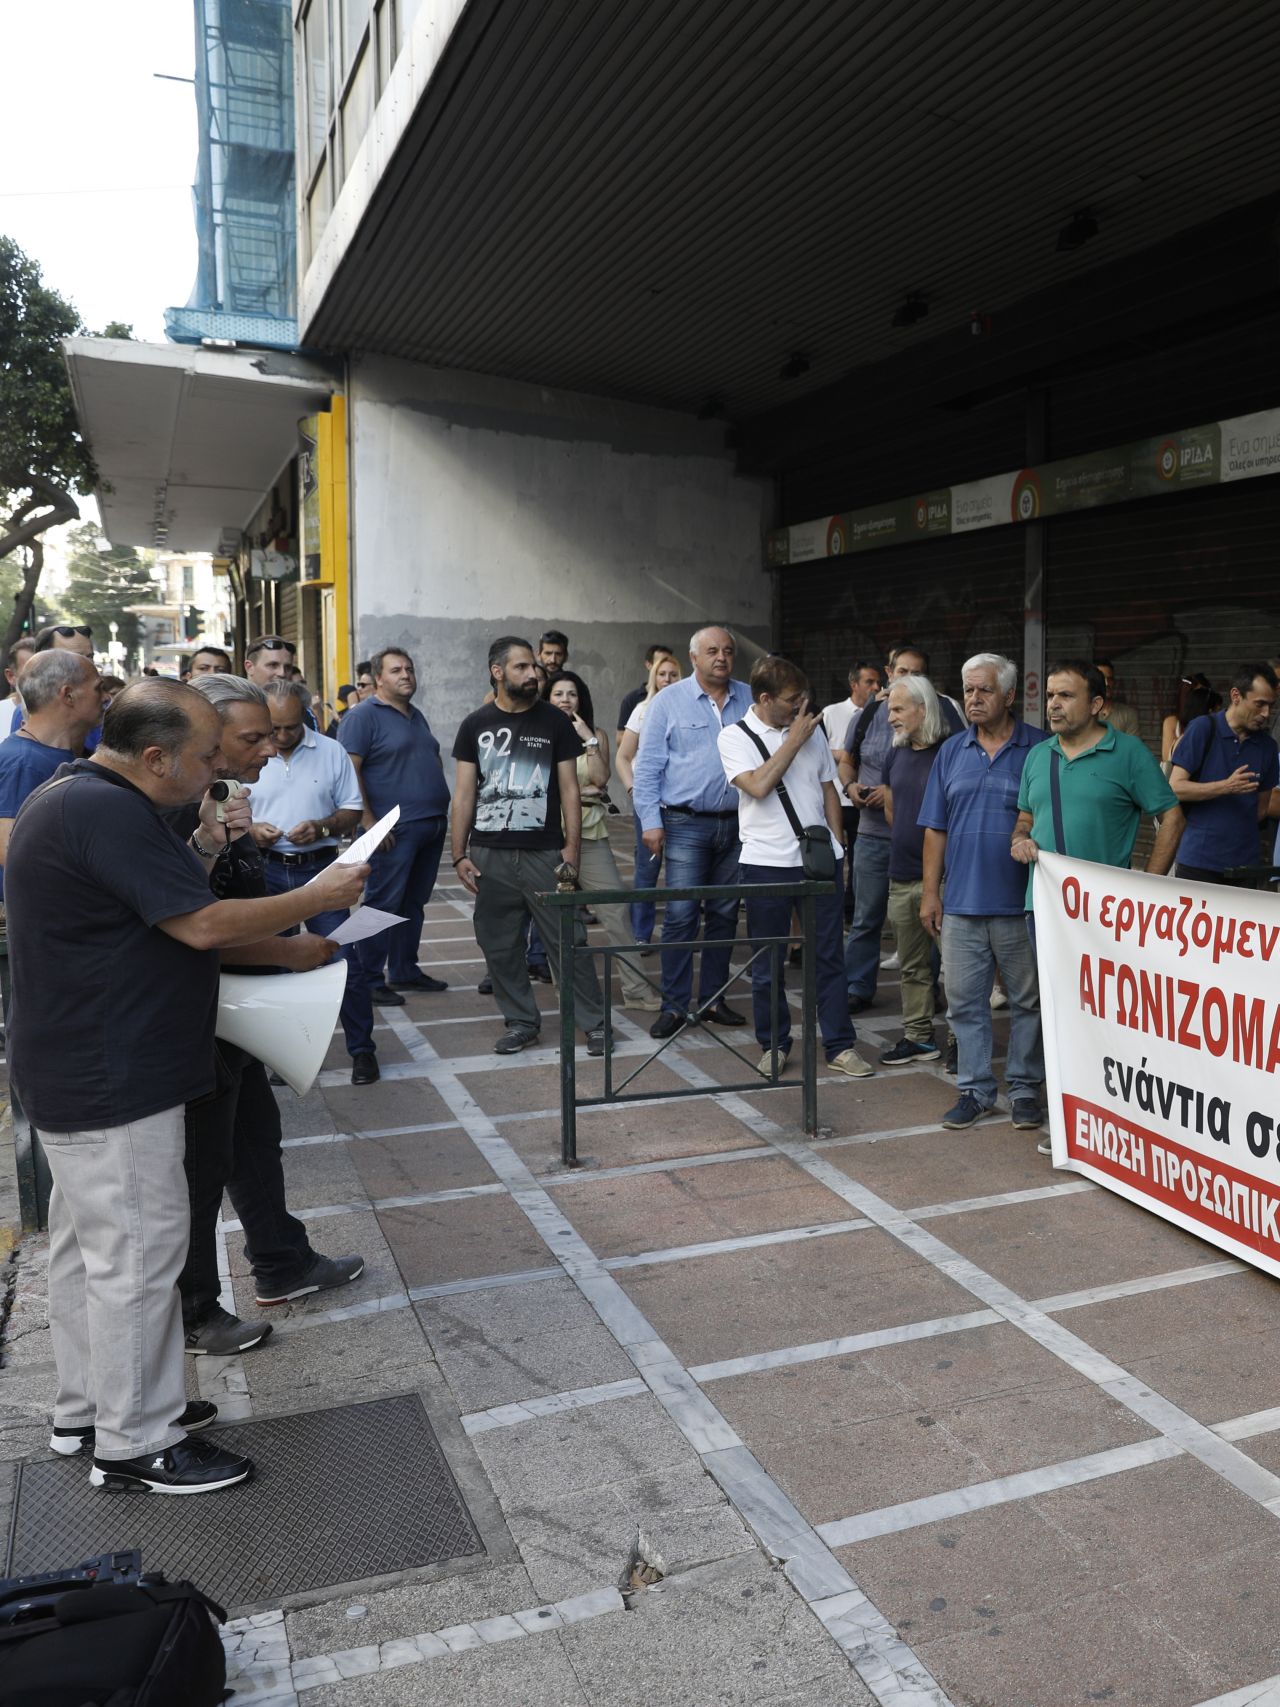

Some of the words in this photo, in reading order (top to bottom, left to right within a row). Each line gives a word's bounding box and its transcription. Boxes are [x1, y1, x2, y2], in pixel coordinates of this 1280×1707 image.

[478, 727, 513, 760] 92
[519, 735, 551, 745] CALIFORNIA
[507, 762, 546, 791] LA
[1061, 876, 1090, 920] Οι
[1103, 1055, 1230, 1145] ενάντια
[1075, 1108, 1146, 1177] ΕΝΩΣΗ
